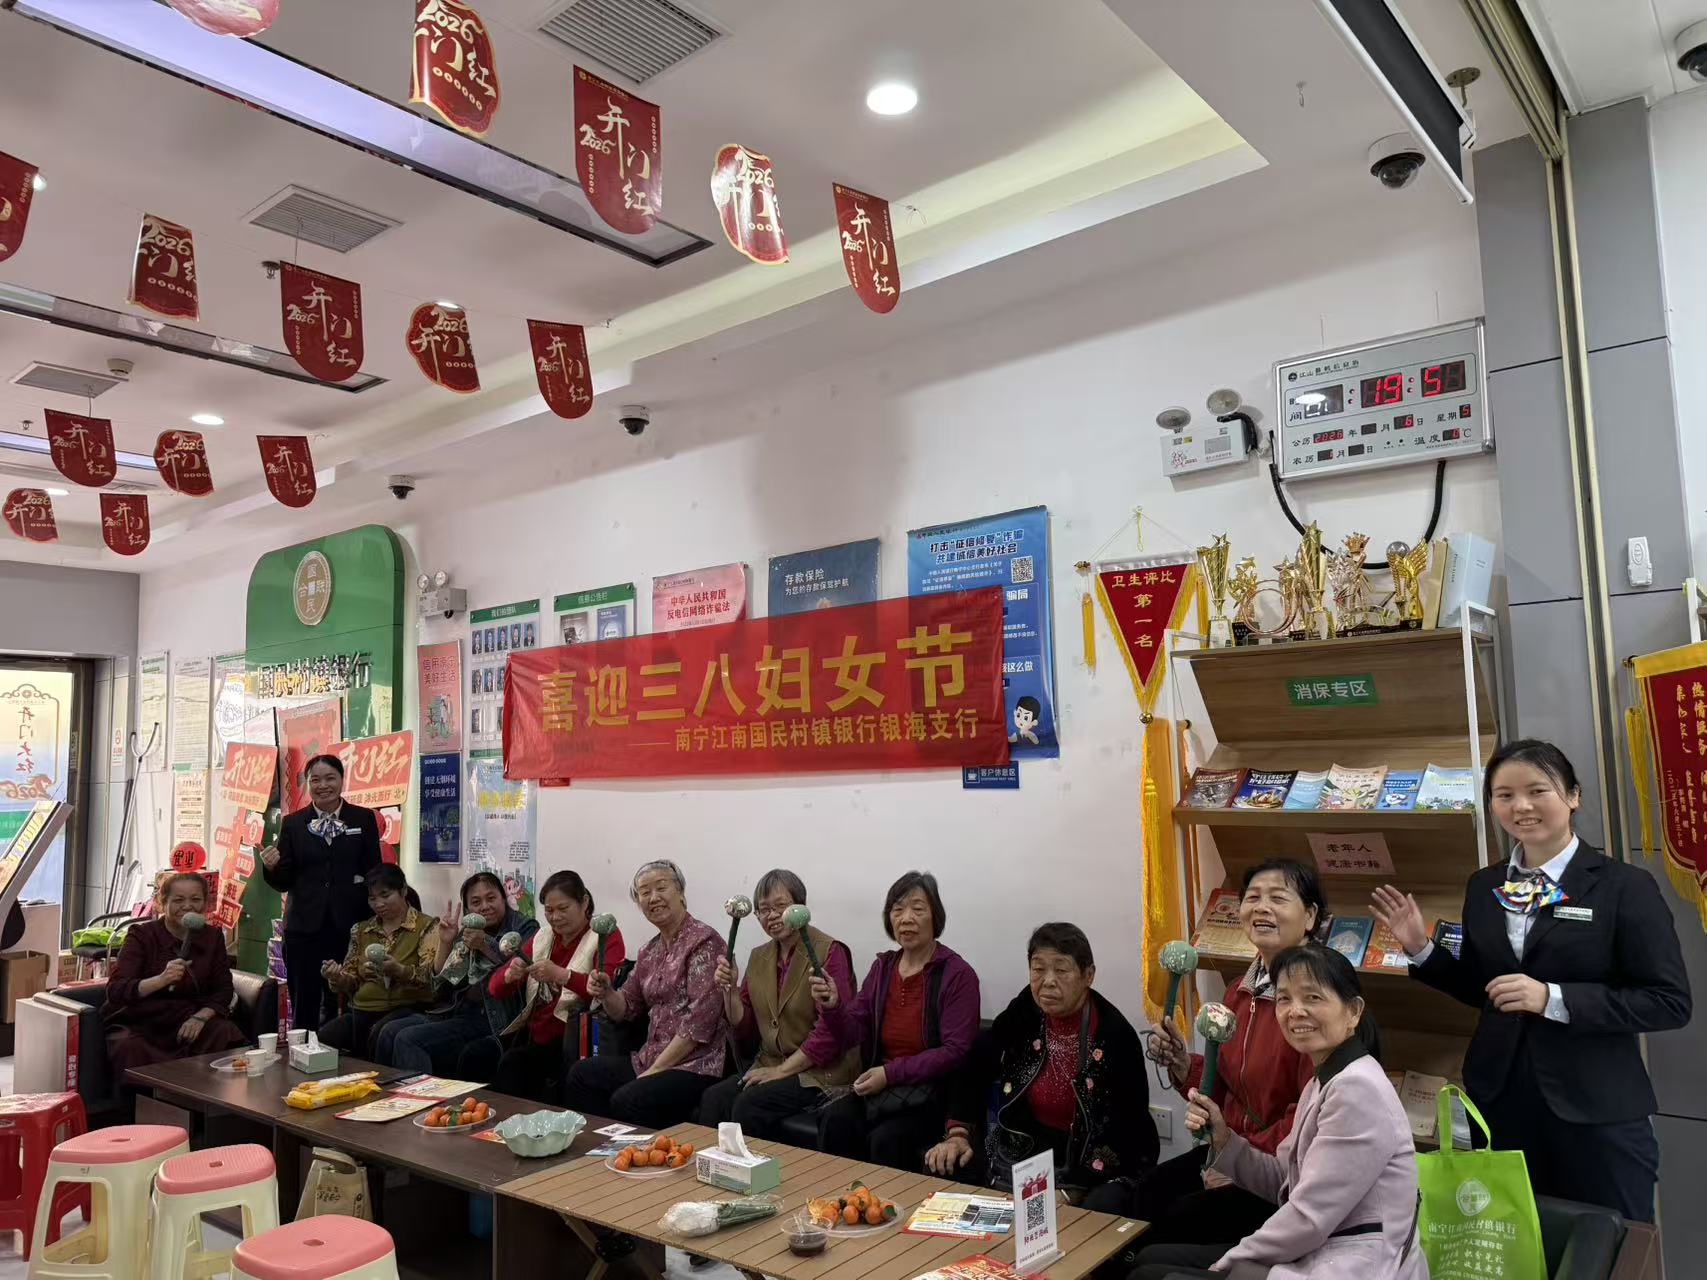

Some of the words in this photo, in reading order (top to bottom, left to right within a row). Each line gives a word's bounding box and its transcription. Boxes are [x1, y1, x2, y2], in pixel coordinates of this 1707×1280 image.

[417, 0, 483, 44] 2026
[579, 123, 616, 155] 2026
[596, 96, 655, 216] 开门红
[735, 148, 775, 188] 2026
[141, 221, 192, 255] 2026
[842, 231, 865, 253] 2026
[850, 203, 896, 296] 开门红
[286, 304, 319, 324] 2026
[303, 281, 357, 367] 开门红
[431, 306, 468, 332] 2026
[546, 332, 590, 403] 开门红
[1375, 373, 1403, 405] 19
[1348, 429, 1357, 438] 年
[1381, 422, 1390, 432] 月
[1416, 418, 1424, 426] 日
[1437, 411, 1457, 423] 星期
[64, 420, 112, 477] 开门红
[172, 432, 204, 451] 2026
[1336, 449, 1345, 458] 月
[1366, 445, 1374, 453] 日
[1414, 433, 1441, 446] 温度
[274, 443, 312, 496] 开门红
[113, 501, 146, 545] 开门红
[935, 543, 1018, 565] 共建诚信美好社会
[785, 568, 825, 586] 存款保险
[785, 578, 849, 596] 为您的存款保驾护航
[1112, 570, 1176, 588] 卫生评比
[671, 588, 727, 607] 中华人民共和国
[1007, 588, 1028, 601] 骗局
[667, 601, 731, 620] 反电信网络诈骗法
[1133, 593, 1153, 648] 第一名
[538, 623, 973, 733] 喜迎三八妇女节
[1294, 680, 1369, 700] 消保专区
[981, 768, 1017, 777] 客户休息区
[1327, 843, 1372, 853] 老年人
